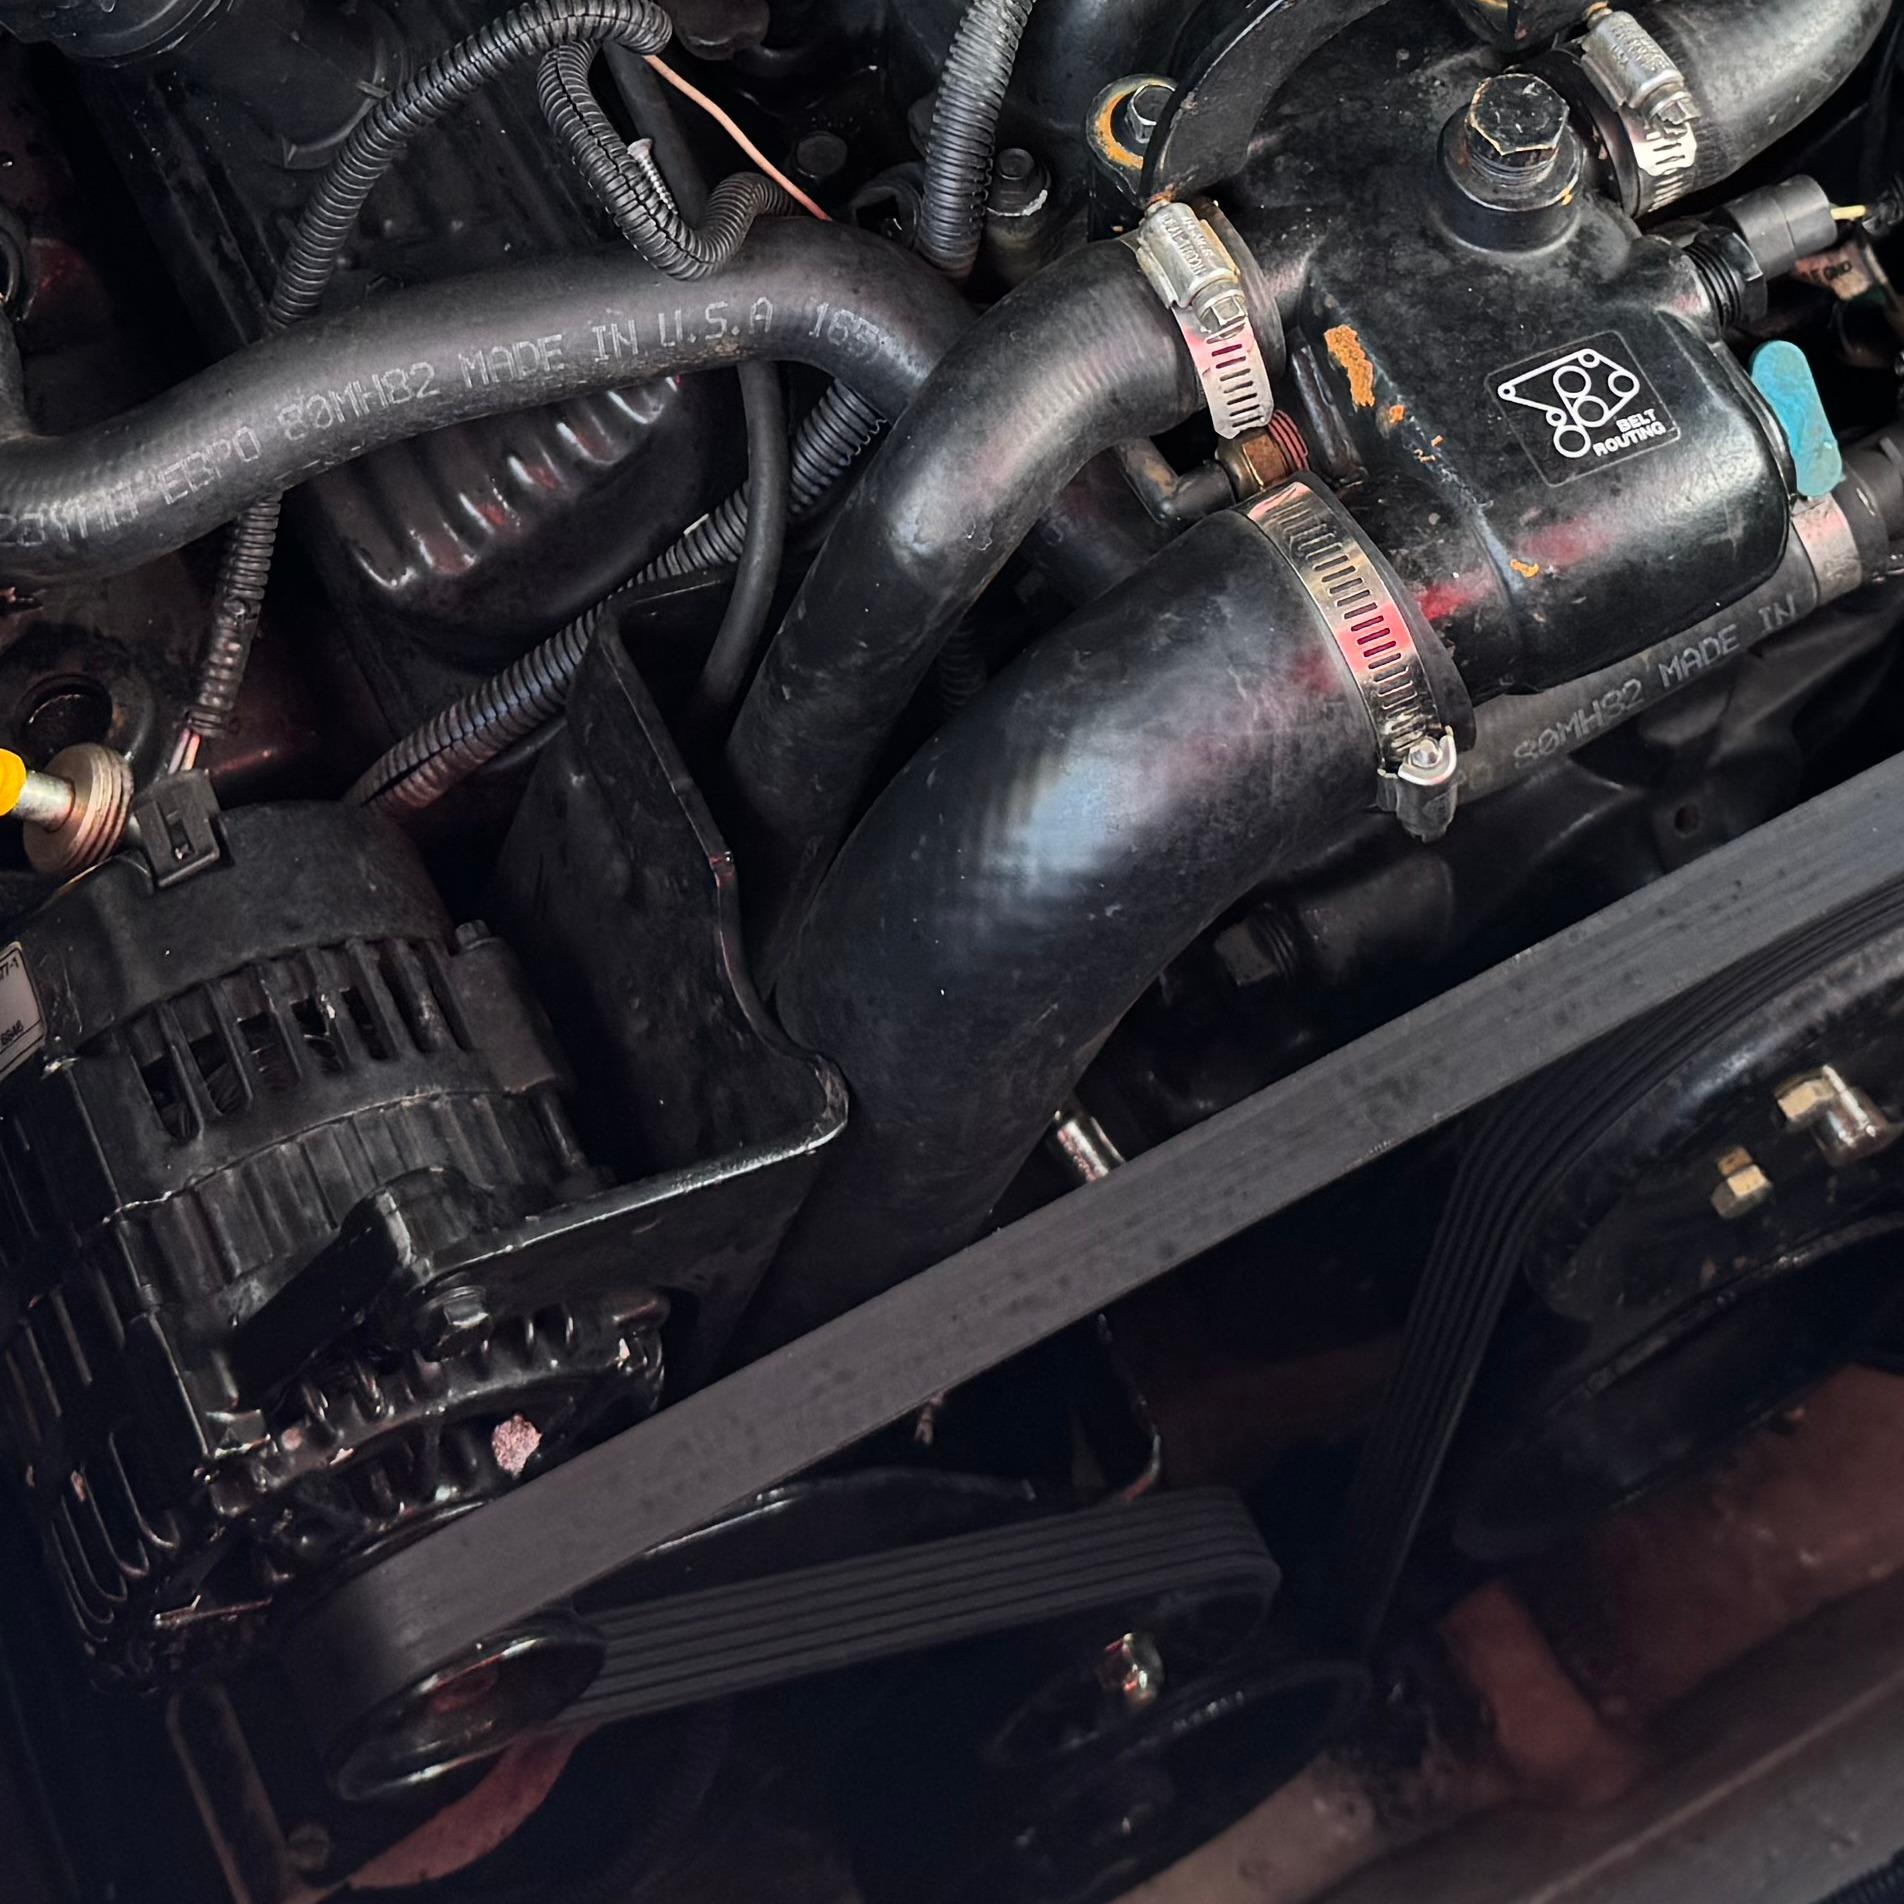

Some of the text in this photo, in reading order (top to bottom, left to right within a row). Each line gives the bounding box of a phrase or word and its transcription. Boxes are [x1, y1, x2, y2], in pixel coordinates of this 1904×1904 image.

[459, 332, 566, 390] MADE
[590, 318, 639, 363] IN
[1591, 419, 1667, 458] ROUTING
[1615, 406, 1658, 433] BELT
[1656, 621, 1743, 689] MADE
[1756, 590, 1799, 634] IN
